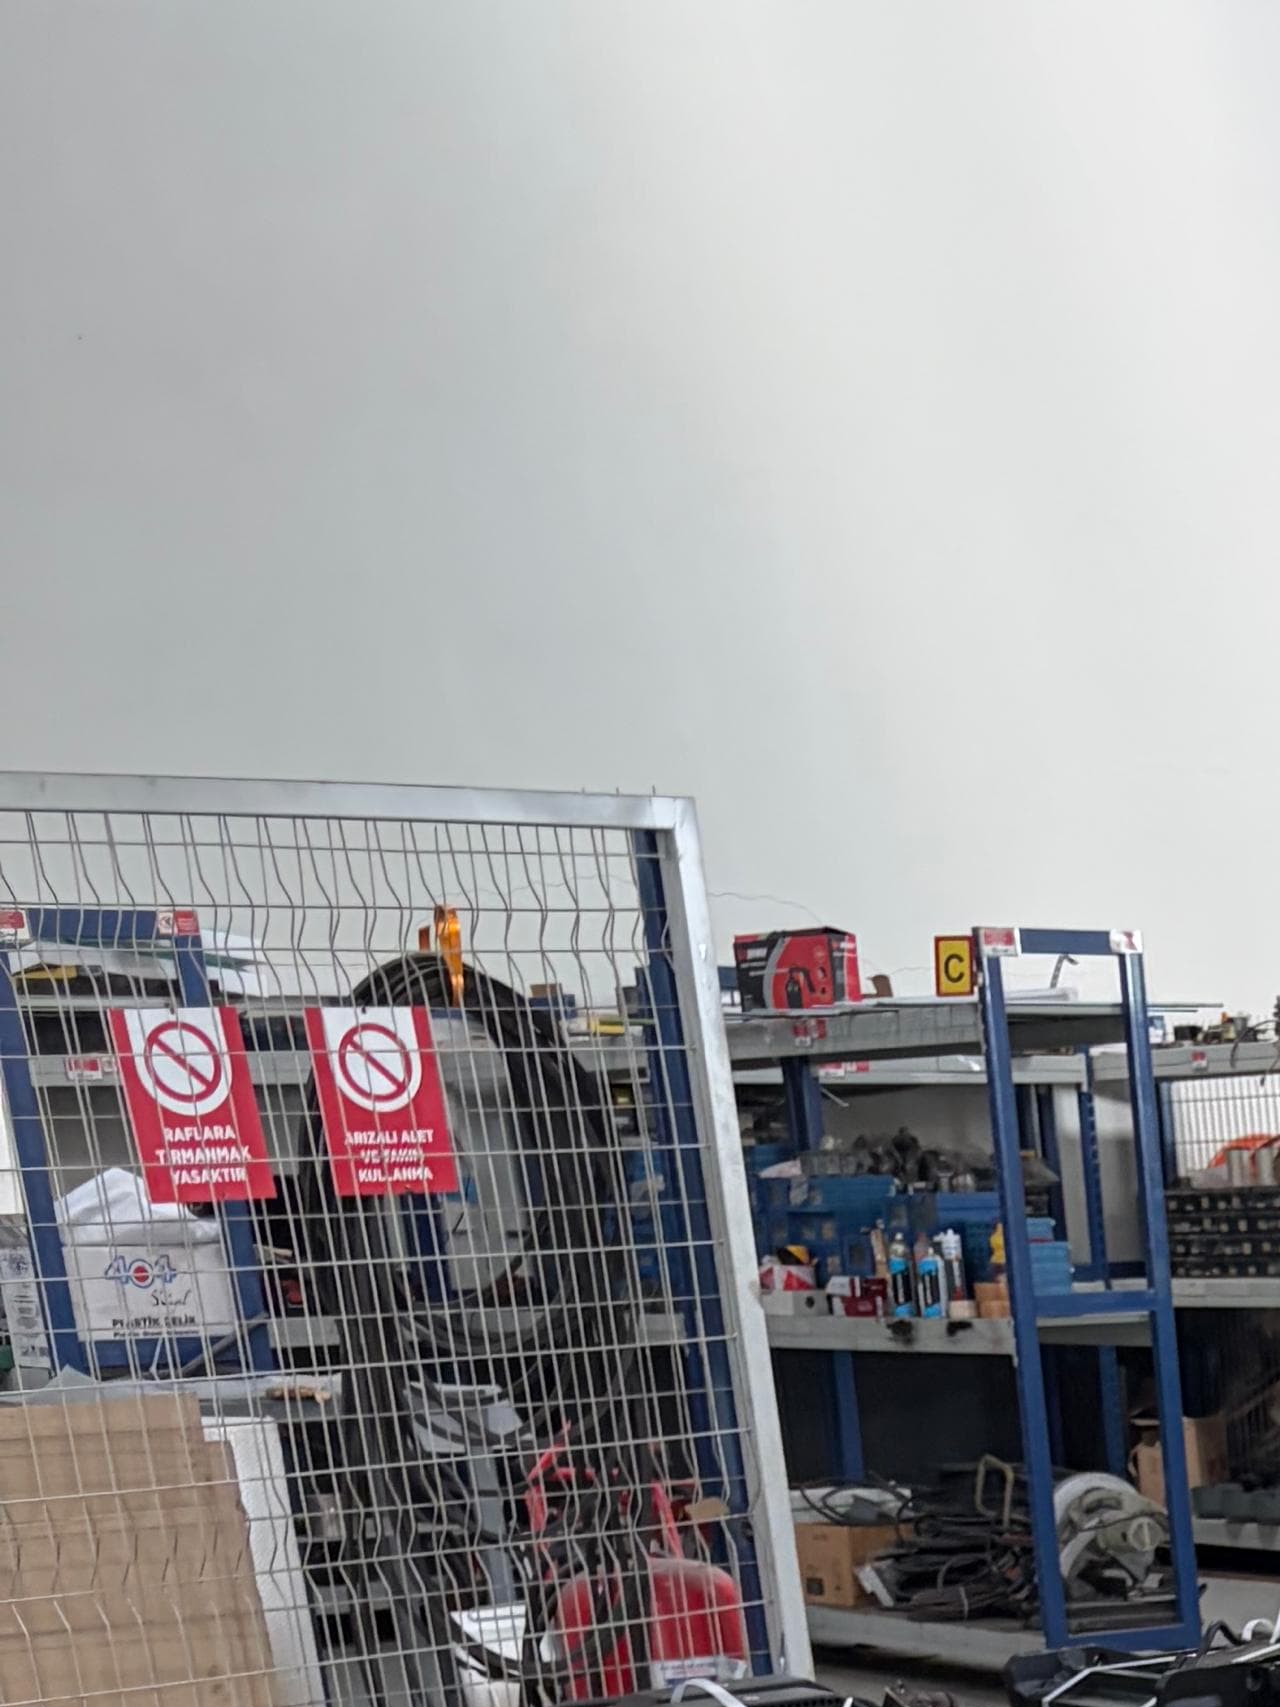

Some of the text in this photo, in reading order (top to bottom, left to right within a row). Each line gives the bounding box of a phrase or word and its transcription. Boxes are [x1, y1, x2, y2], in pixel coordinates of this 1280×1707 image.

[944, 953, 965, 983] C
[164, 1125, 236, 1142] RAFLARA
[344, 1128, 433, 1145] ARIZALI ALET
[155, 1145, 252, 1165] TRMANMAK
[172, 1167, 246, 1184] YASAKTIR
